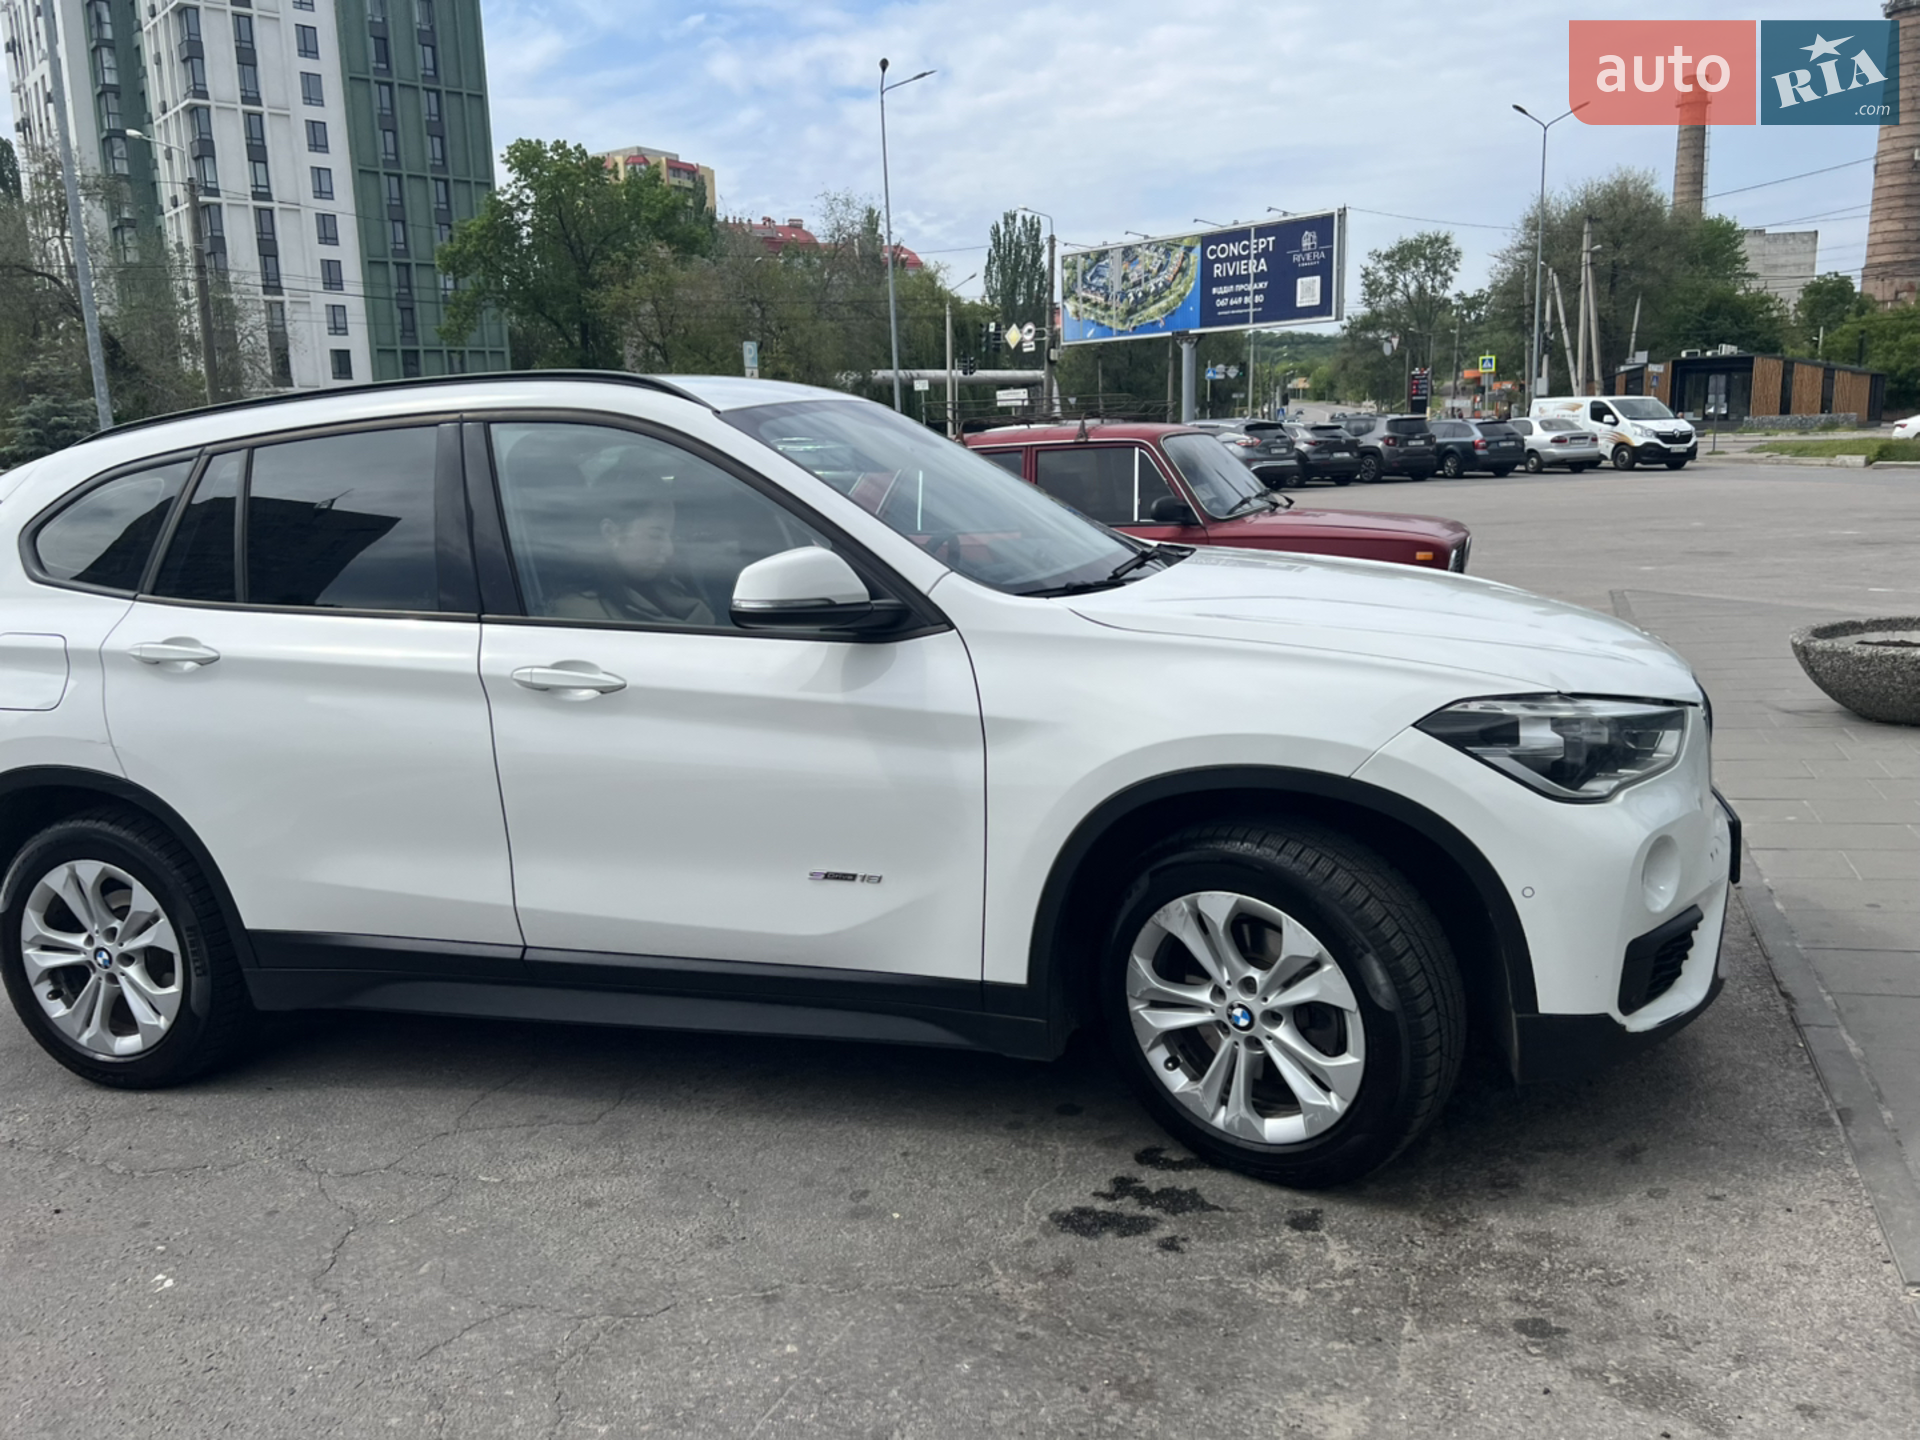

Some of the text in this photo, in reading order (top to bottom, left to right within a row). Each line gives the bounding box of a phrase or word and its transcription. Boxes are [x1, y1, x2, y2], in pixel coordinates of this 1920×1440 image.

[1206, 236, 1276, 260] CONCEPT
[1292, 250, 1327, 263] RIVIERA
[1213, 257, 1268, 278] RIVIERA
